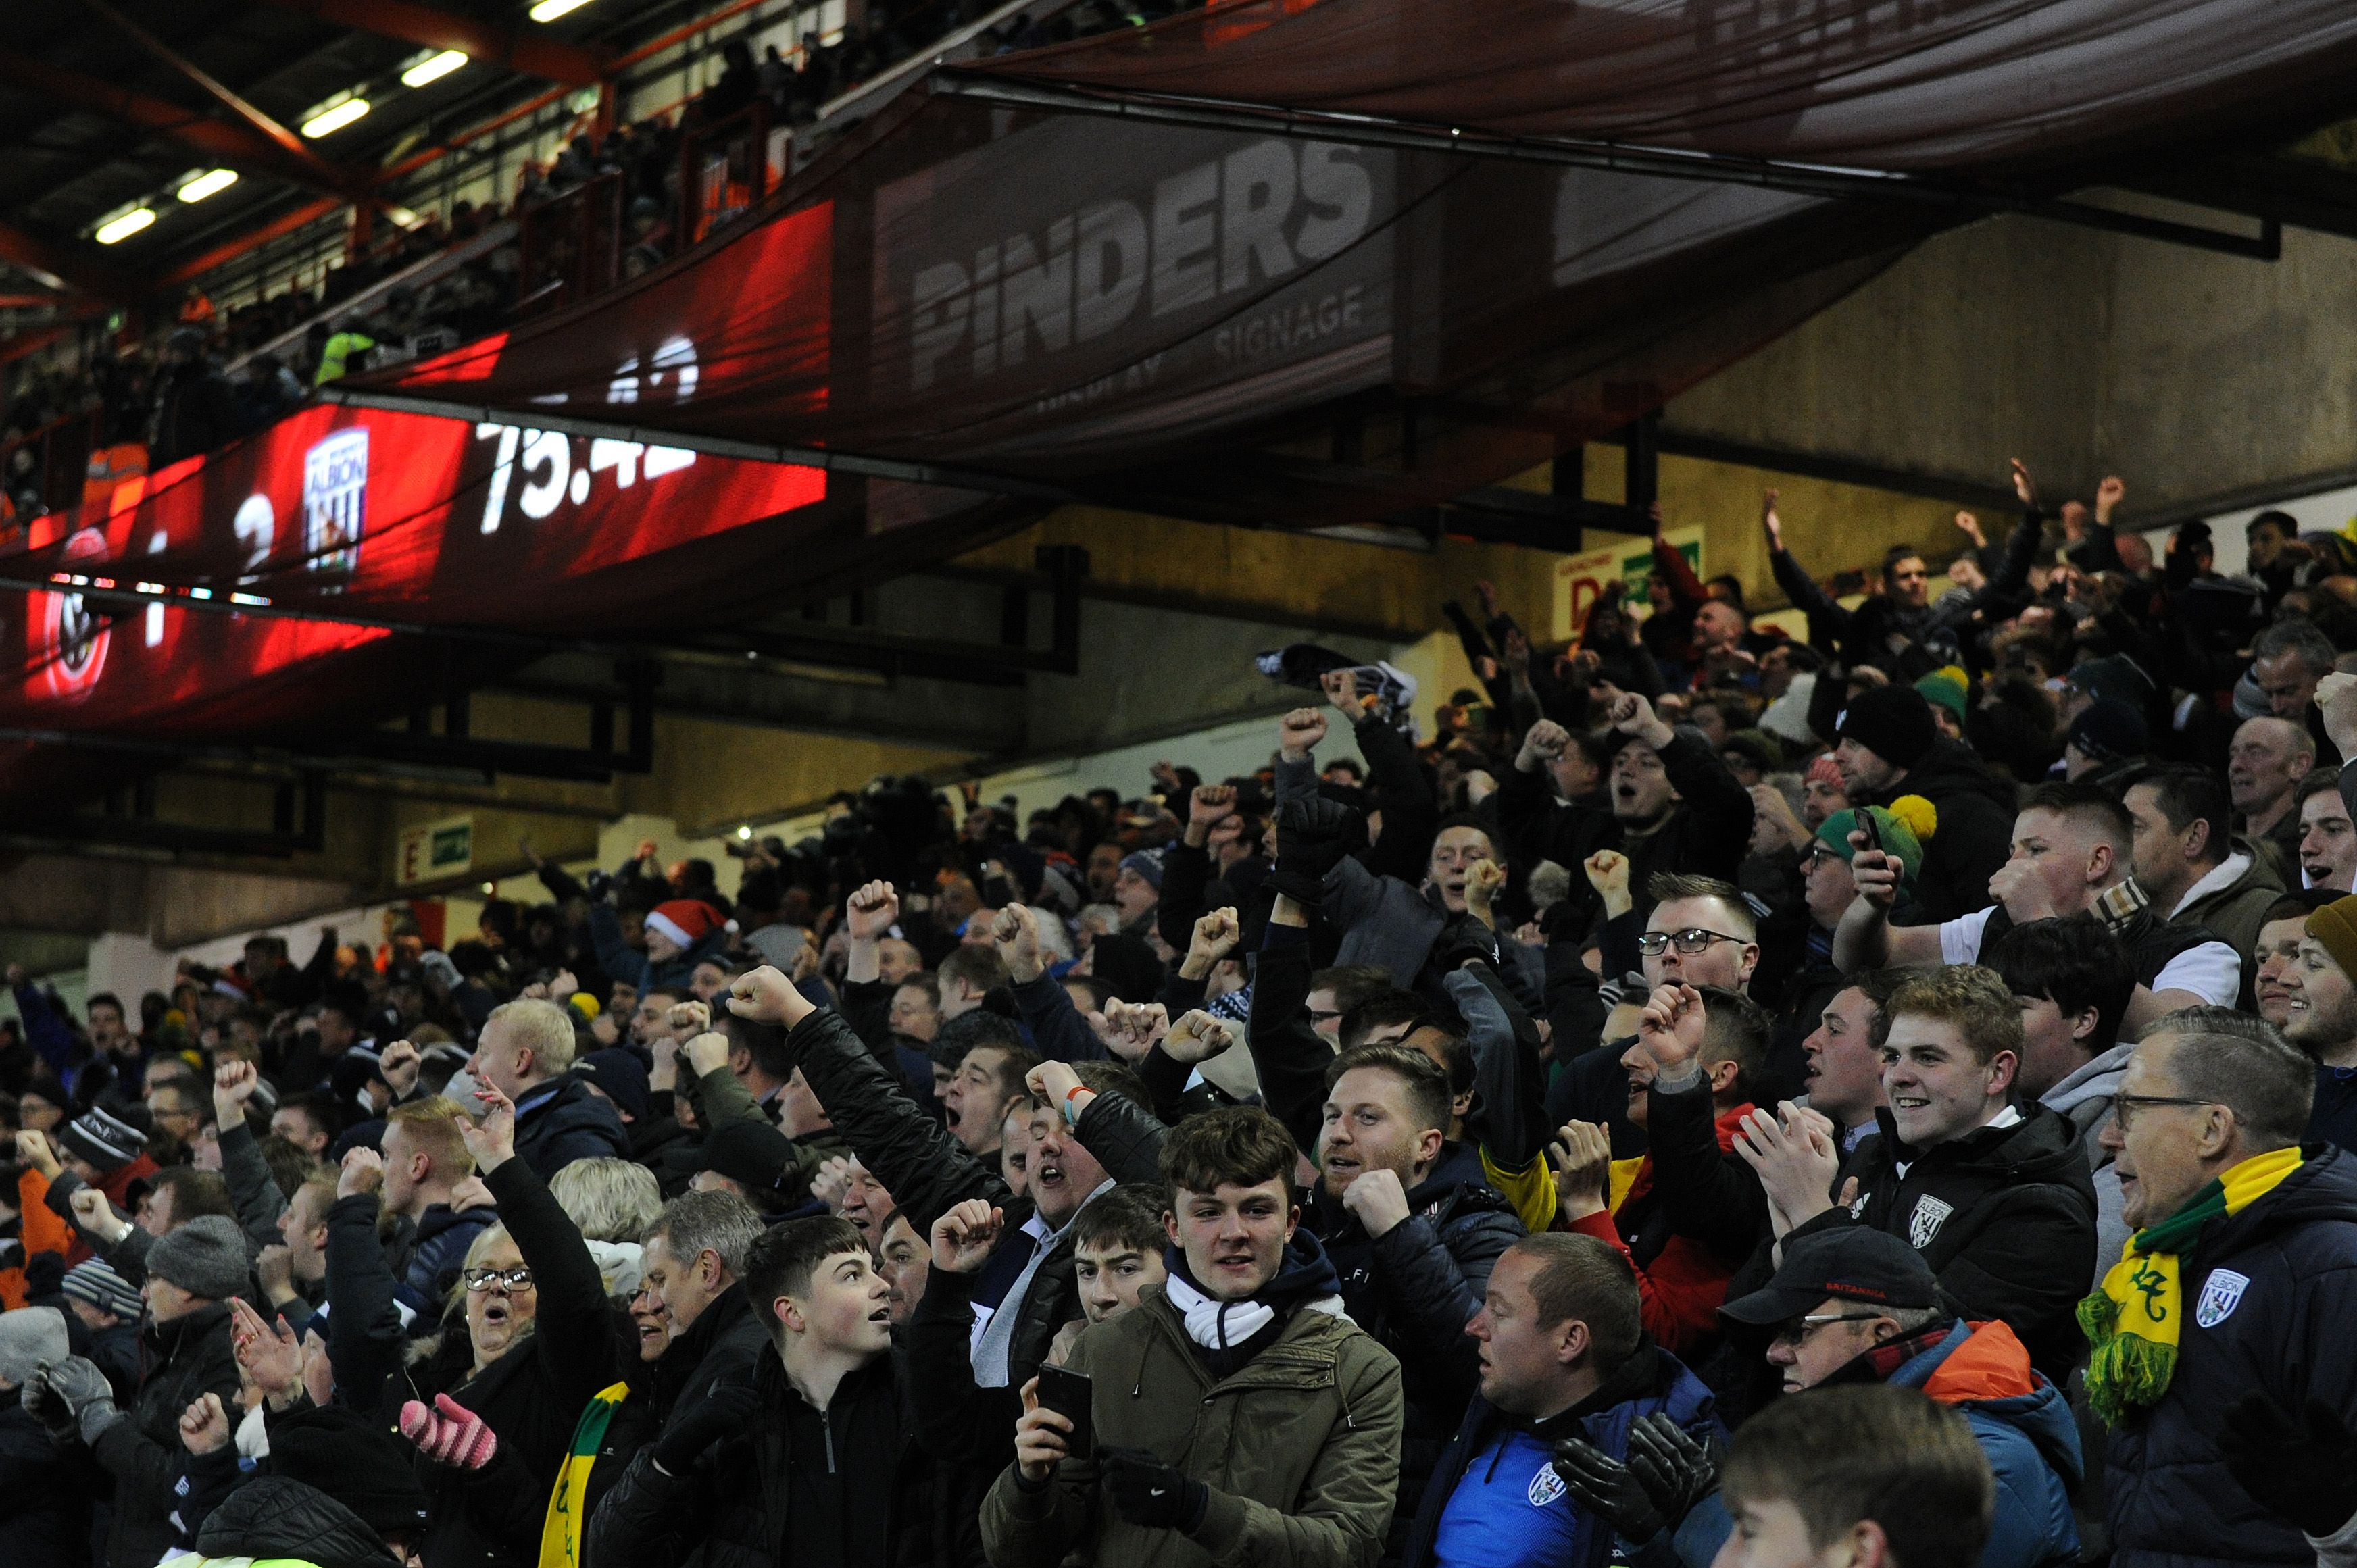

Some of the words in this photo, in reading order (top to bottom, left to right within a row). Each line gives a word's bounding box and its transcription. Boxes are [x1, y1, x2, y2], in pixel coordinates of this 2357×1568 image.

[912, 138, 1374, 393] PINDERS
[1214, 285, 1364, 363] SIGNAGE
[1918, 1202, 1947, 1219] ALBION
[2208, 1277, 2240, 1293] ALBION
